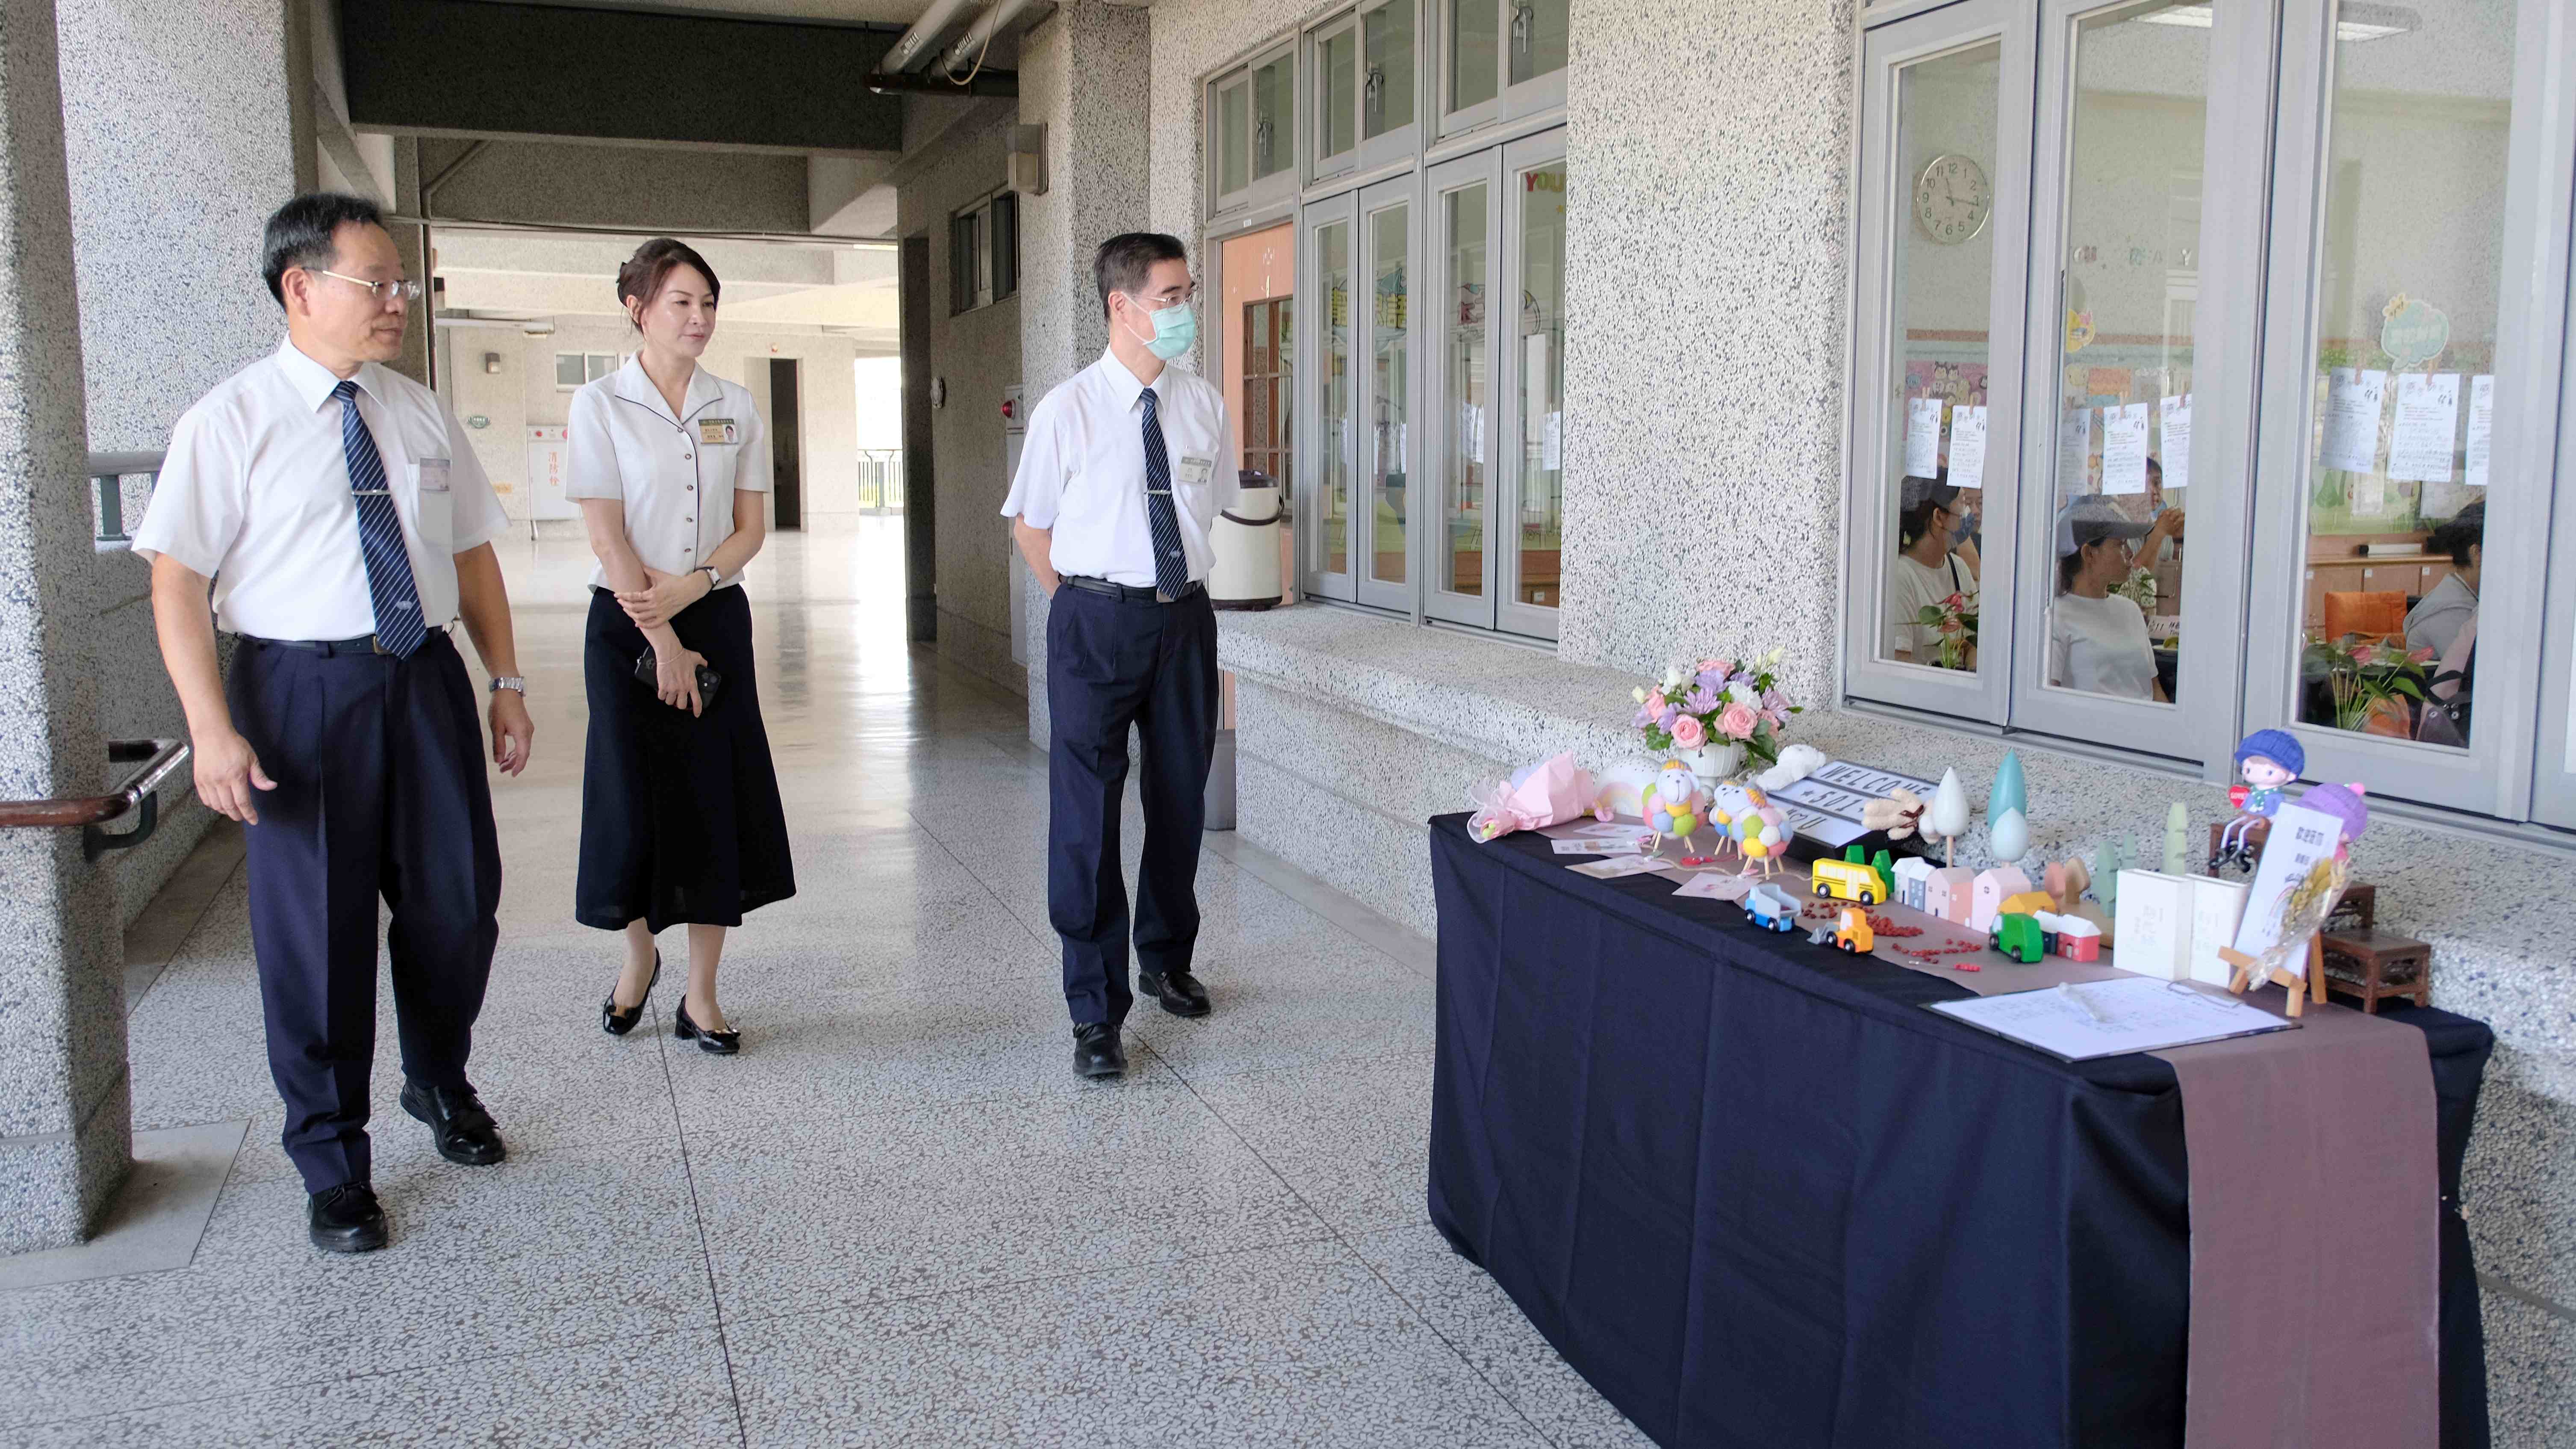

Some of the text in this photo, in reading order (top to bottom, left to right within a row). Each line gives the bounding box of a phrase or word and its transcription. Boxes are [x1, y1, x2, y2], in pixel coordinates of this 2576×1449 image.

[1936, 166, 1943, 177] 11
[1948, 163, 1957, 174] 12
[1525, 171, 1566, 192] YOU
[1927, 178, 1935, 189] 10
[1970, 180, 1976, 191] 2
[1923, 192, 1929, 203] 9
[1925, 208, 1931, 218] 8
[1968, 211, 1974, 221] 4
[1935, 220, 1941, 231] 7
[1946, 224, 1952, 235] 6
[1958, 221, 1965, 232] 5
[1808, 791, 1863, 812] 501
